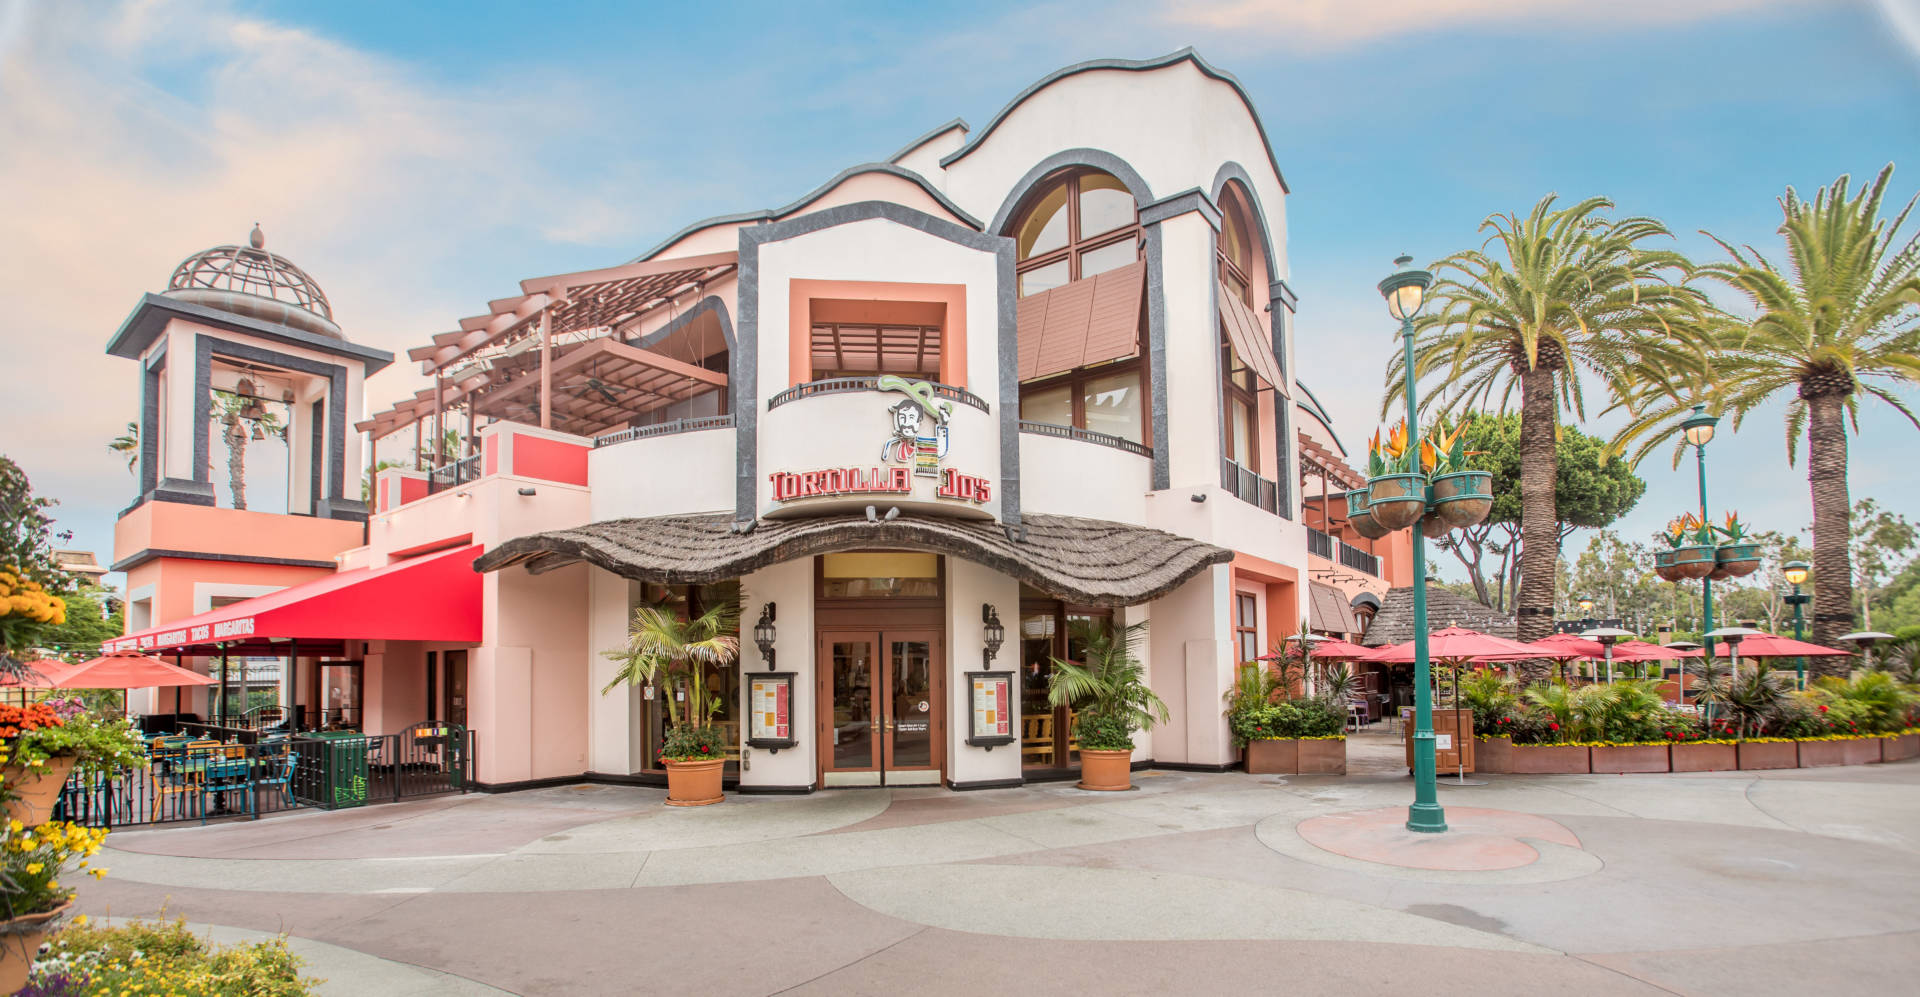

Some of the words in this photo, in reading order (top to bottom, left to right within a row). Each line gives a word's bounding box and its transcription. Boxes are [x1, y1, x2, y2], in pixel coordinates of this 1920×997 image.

[769, 467, 911, 502] TORTILLA
[937, 468, 992, 502] JO'S
[191, 625, 209, 641] TACOS
[214, 618, 255, 638] MARGARITAS
